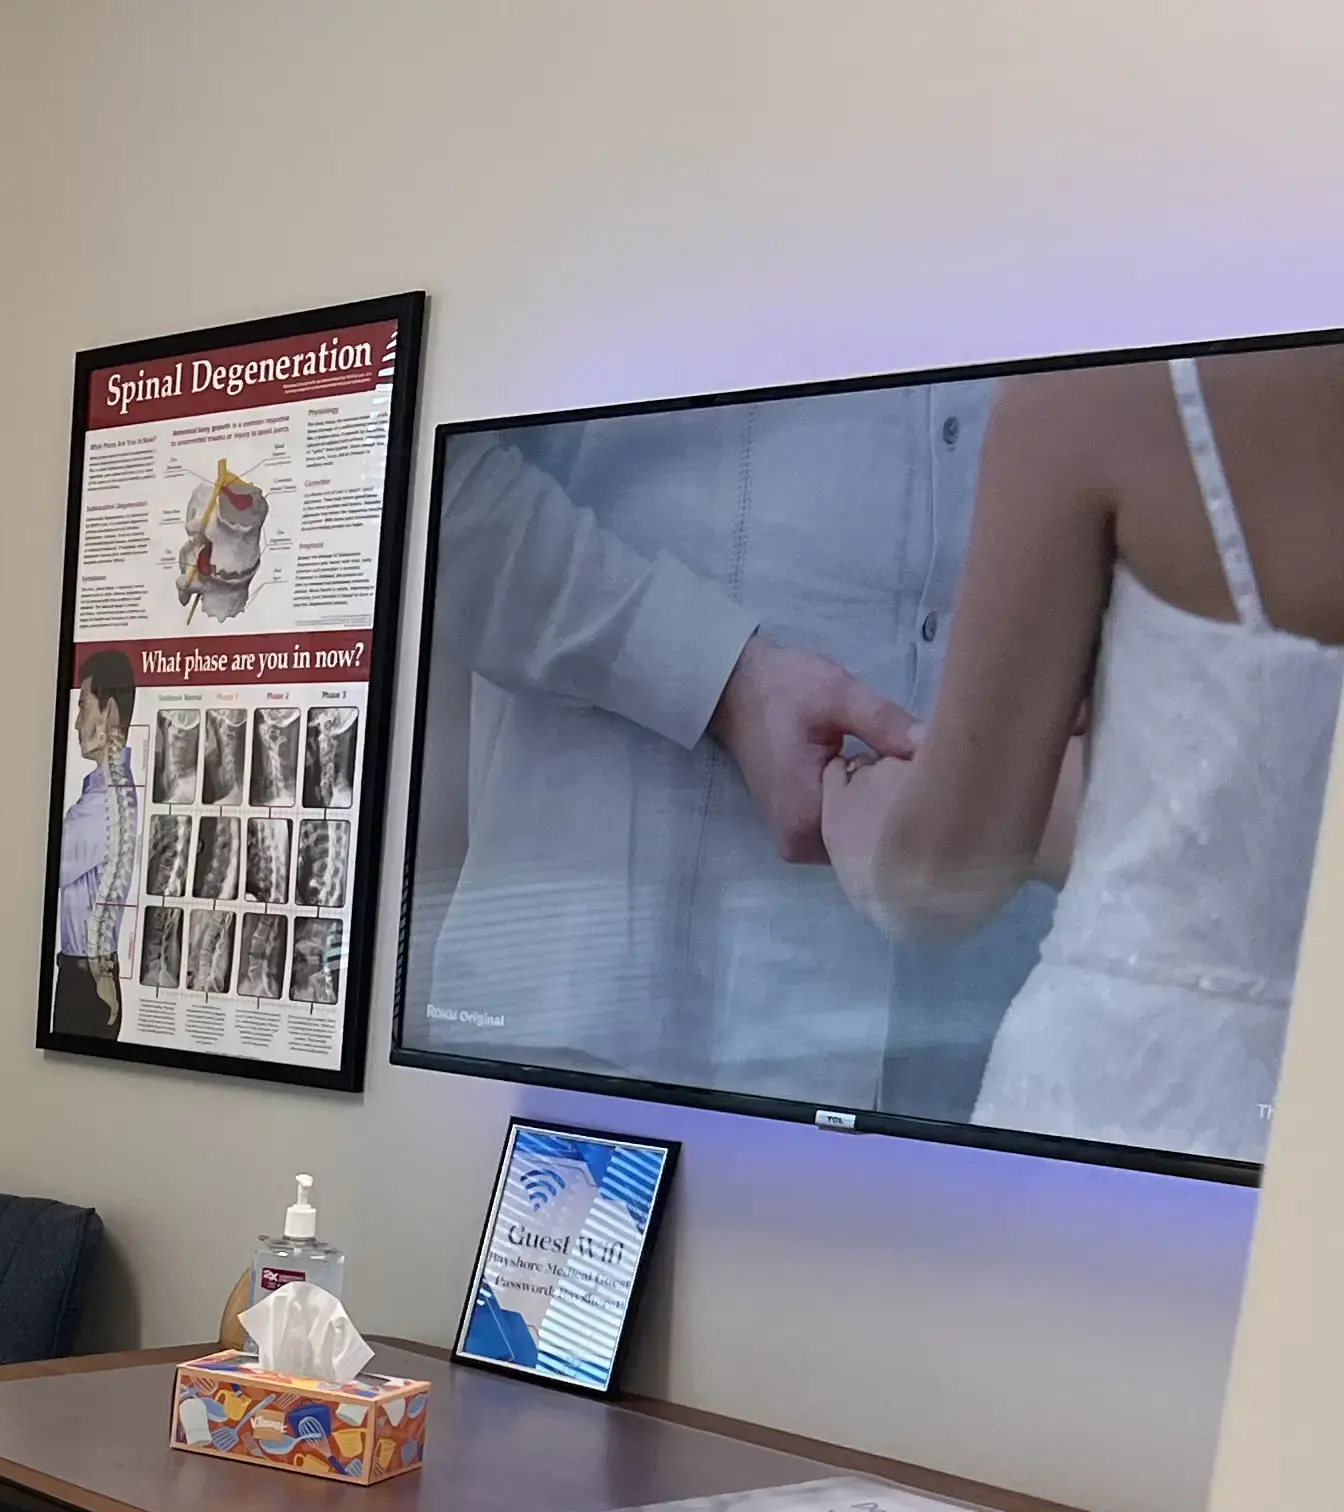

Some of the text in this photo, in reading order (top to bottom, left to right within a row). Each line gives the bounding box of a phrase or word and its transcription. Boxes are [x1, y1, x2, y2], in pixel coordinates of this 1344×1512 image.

[106, 337, 372, 415] Spinal Degeneration
[141, 642, 364, 680] What phase are you in now?
[459, 1010, 505, 1027] Original
[508, 1224, 624, 1264] Guest Wifi
